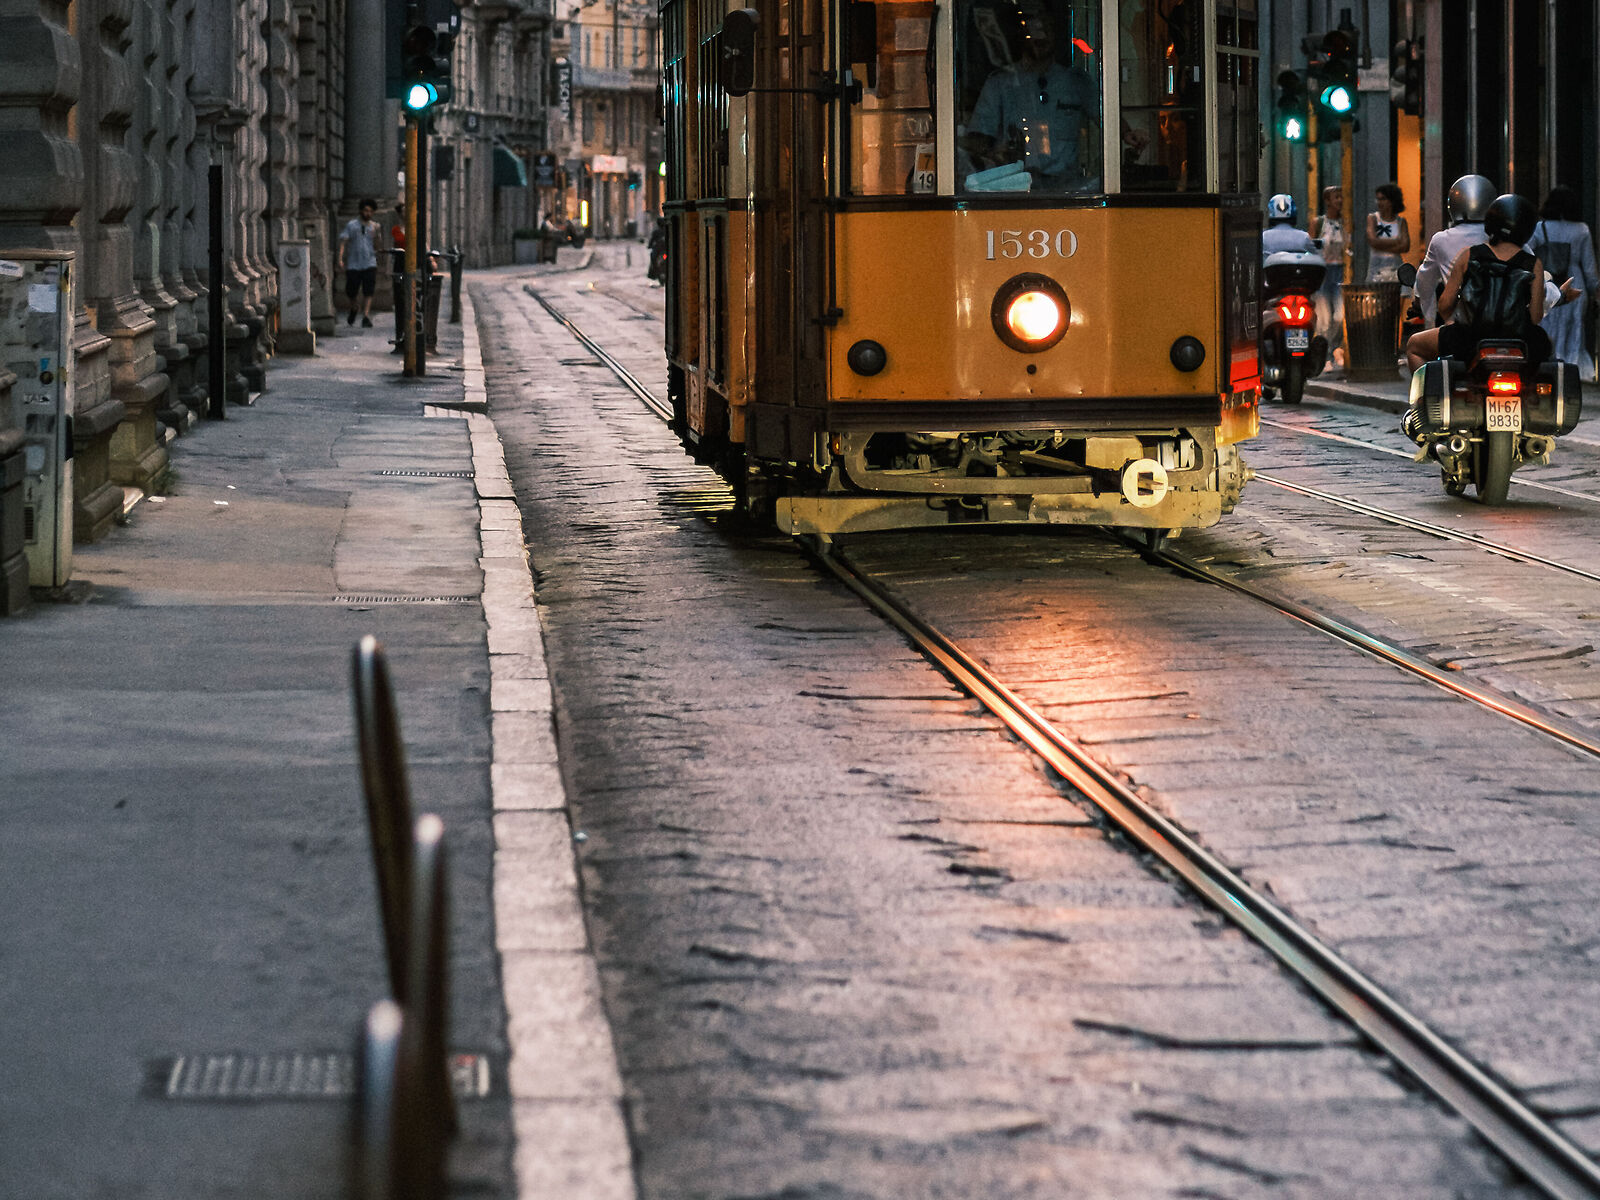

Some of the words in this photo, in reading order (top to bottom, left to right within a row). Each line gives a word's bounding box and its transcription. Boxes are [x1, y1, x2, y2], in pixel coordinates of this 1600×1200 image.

[919, 173, 934, 189] 19
[985, 229, 1079, 260] 1530
[1489, 414, 1520, 428] 9836
